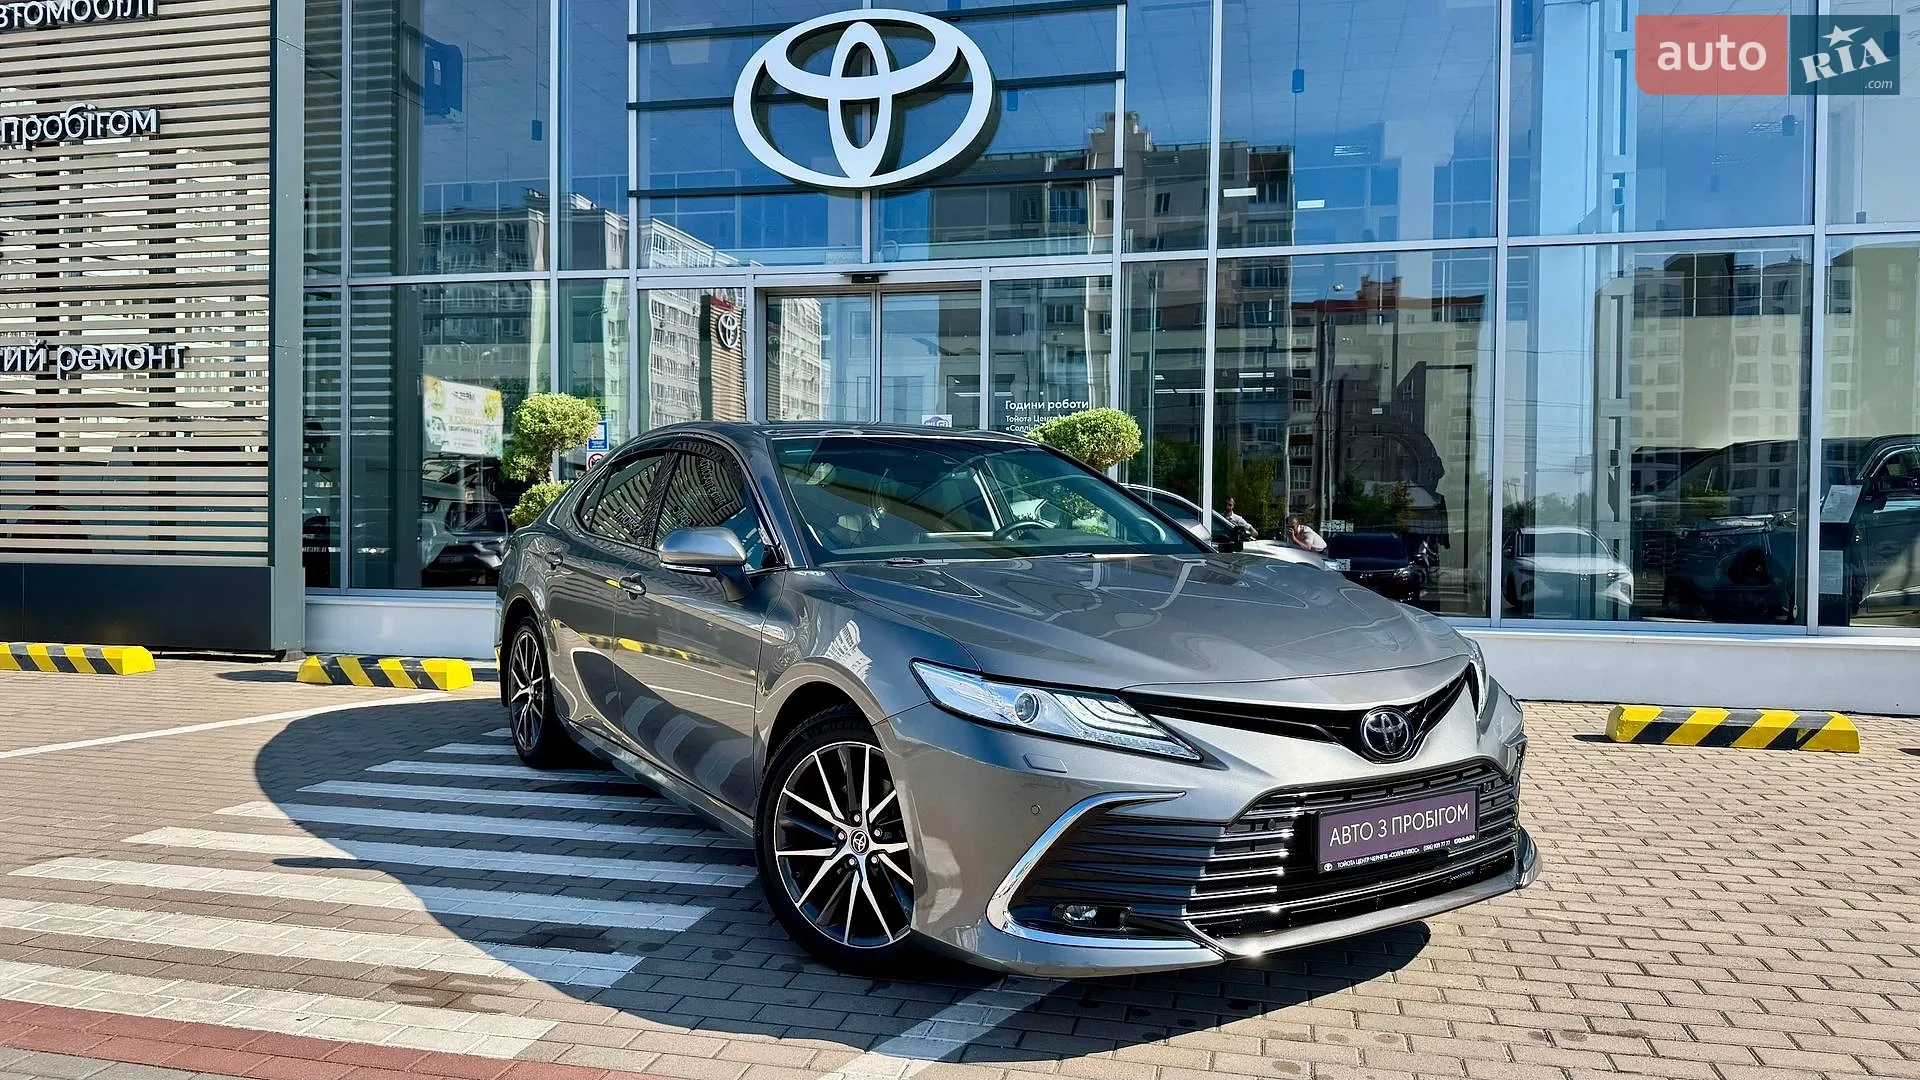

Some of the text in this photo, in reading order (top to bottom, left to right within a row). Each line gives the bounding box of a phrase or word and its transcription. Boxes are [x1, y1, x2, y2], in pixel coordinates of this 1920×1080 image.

[1, 103, 158, 149] пробігом
[0, 338, 185, 380] ий ремонт
[1005, 399, 1089, 411] Години роботи
[1329, 822, 1374, 847] АВТО
[1391, 802, 1470, 836] ПРОБІГОМ
